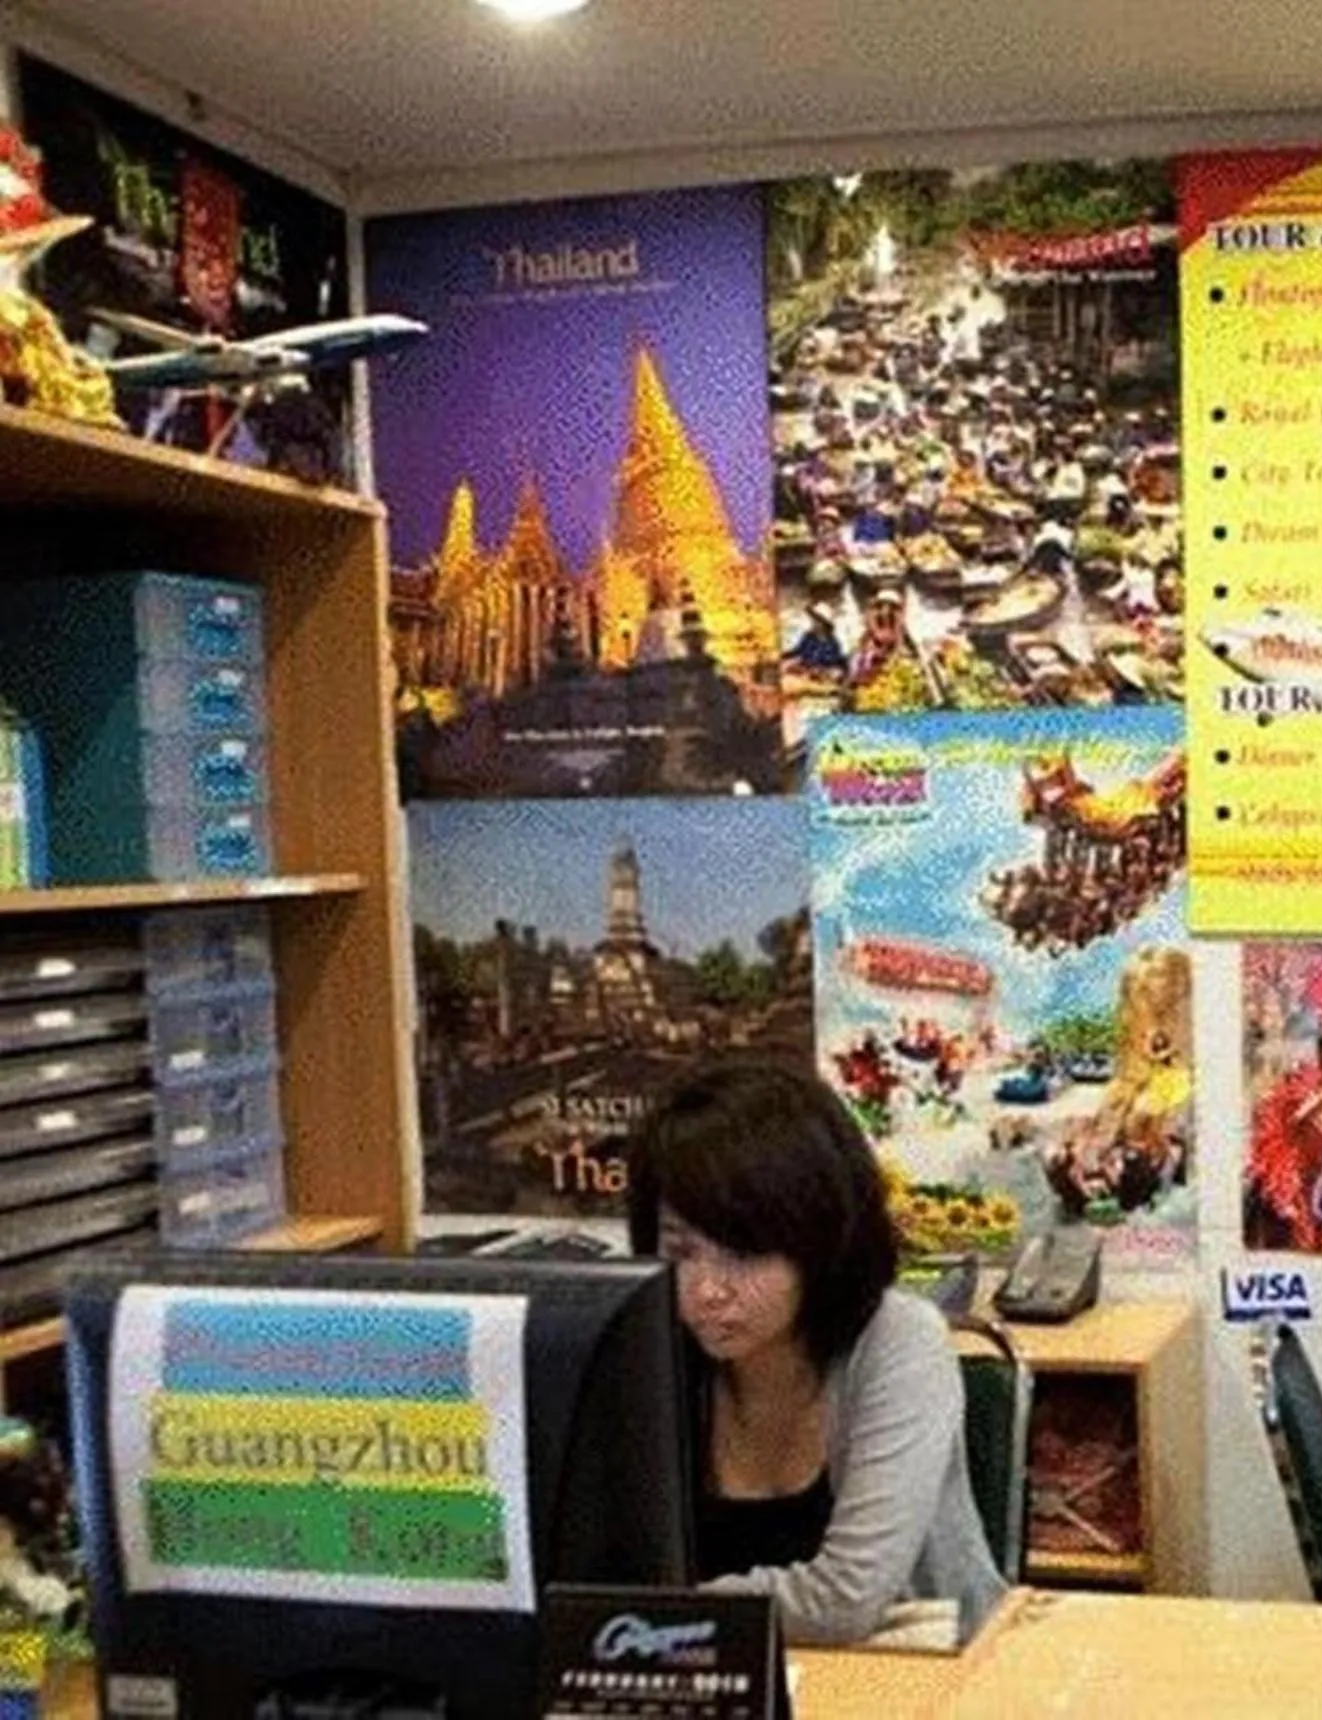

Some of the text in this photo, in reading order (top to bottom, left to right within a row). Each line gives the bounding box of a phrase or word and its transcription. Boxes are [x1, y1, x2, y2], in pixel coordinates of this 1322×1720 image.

[1213, 222, 1306, 251] TOUR
[484, 239, 639, 284] Thailand
[1219, 685, 1312, 712] TOUR
[537, 1139, 629, 1192] Tha
[1235, 1273, 1308, 1301] VISA
[149, 1408, 489, 1484] Guangzhou
